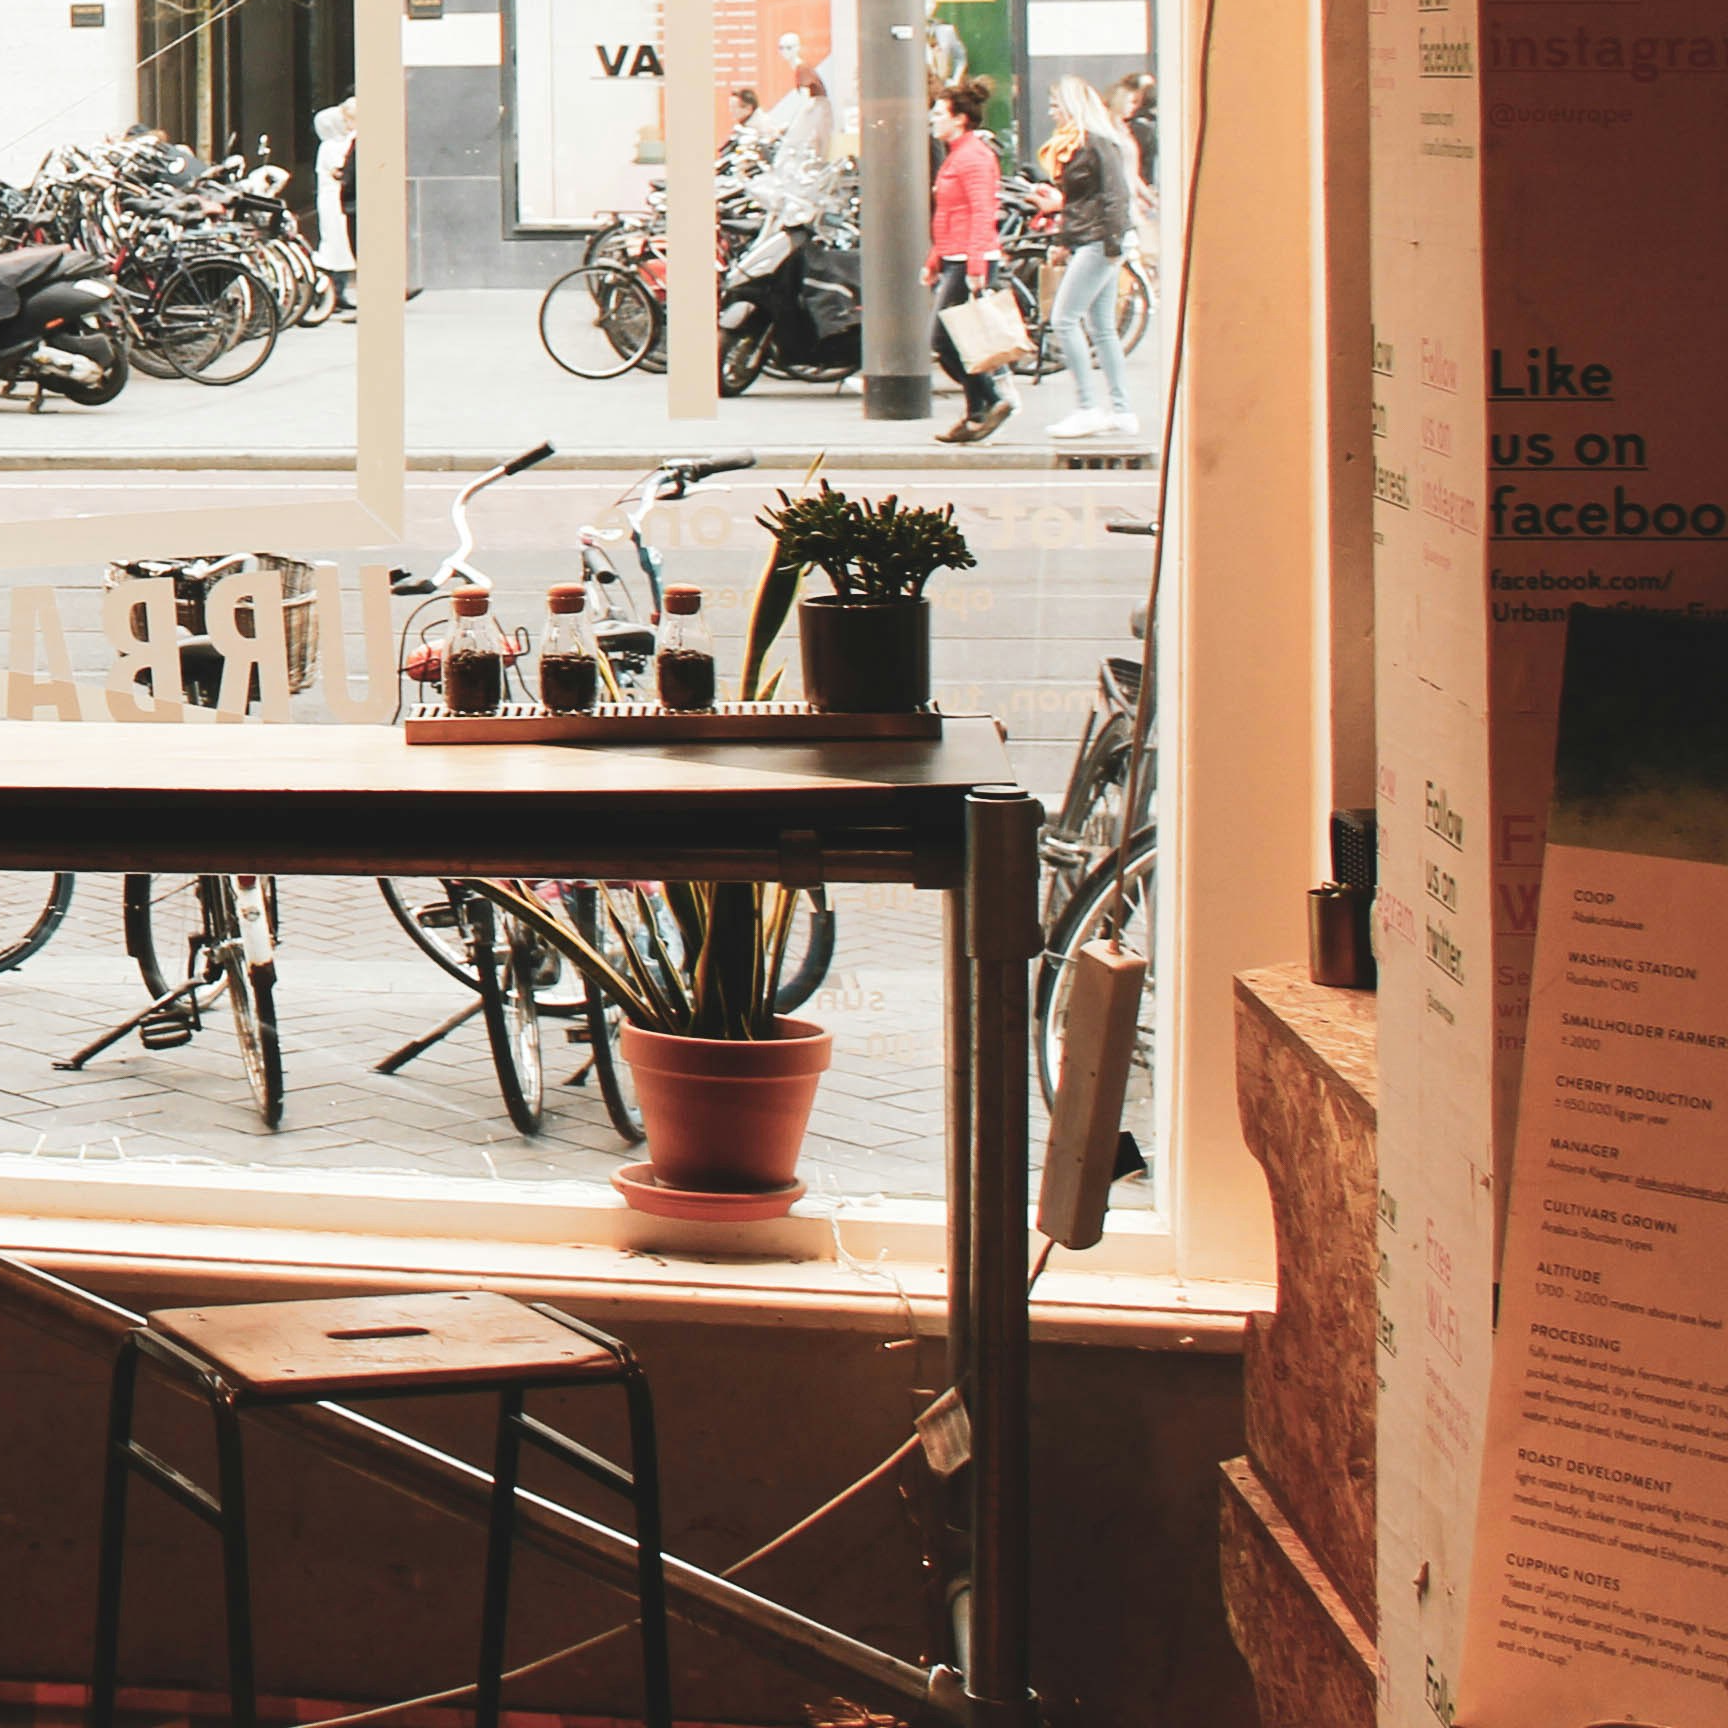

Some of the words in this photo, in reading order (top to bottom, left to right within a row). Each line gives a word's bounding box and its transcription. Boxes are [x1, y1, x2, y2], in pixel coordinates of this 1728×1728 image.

[1490, 347, 1613, 397] Like
[1491, 432, 1554, 466] us
[1575, 430, 1645, 466] on
[1490, 568, 1674, 592] facebook.com/
[1492, 601, 1566, 623] Urban
[1425, 780, 1464, 847] Follow
[1574, 890, 1615, 904] COOP
[1568, 952, 1633, 971] WASHING
[1638, 962, 1697, 979] STATION
[1561, 1013, 1664, 1037] SMALLHOLDER
[1668, 1029, 1728, 1048] FARMER
[1555, 1075, 1611, 1094] CHERRY
[1616, 1085, 1712, 1110] PRODUCTION
[1550, 1138, 1619, 1159] MANAGER
[1543, 1200, 1617, 1223] CULTIVARS
[1622, 1214, 1677, 1233] GROWN
[1537, 1262, 1601, 1284] ALTITUDE
[1530, 1324, 1621, 1352] PROCESSING
[1518, 1448, 1563, 1469] ROAST
[1566, 1459, 1672, 1494] DEVELOPMENT
[1505, 1553, 1568, 1579] CUPPING
[1574, 1568, 1620, 1592] NOTES
